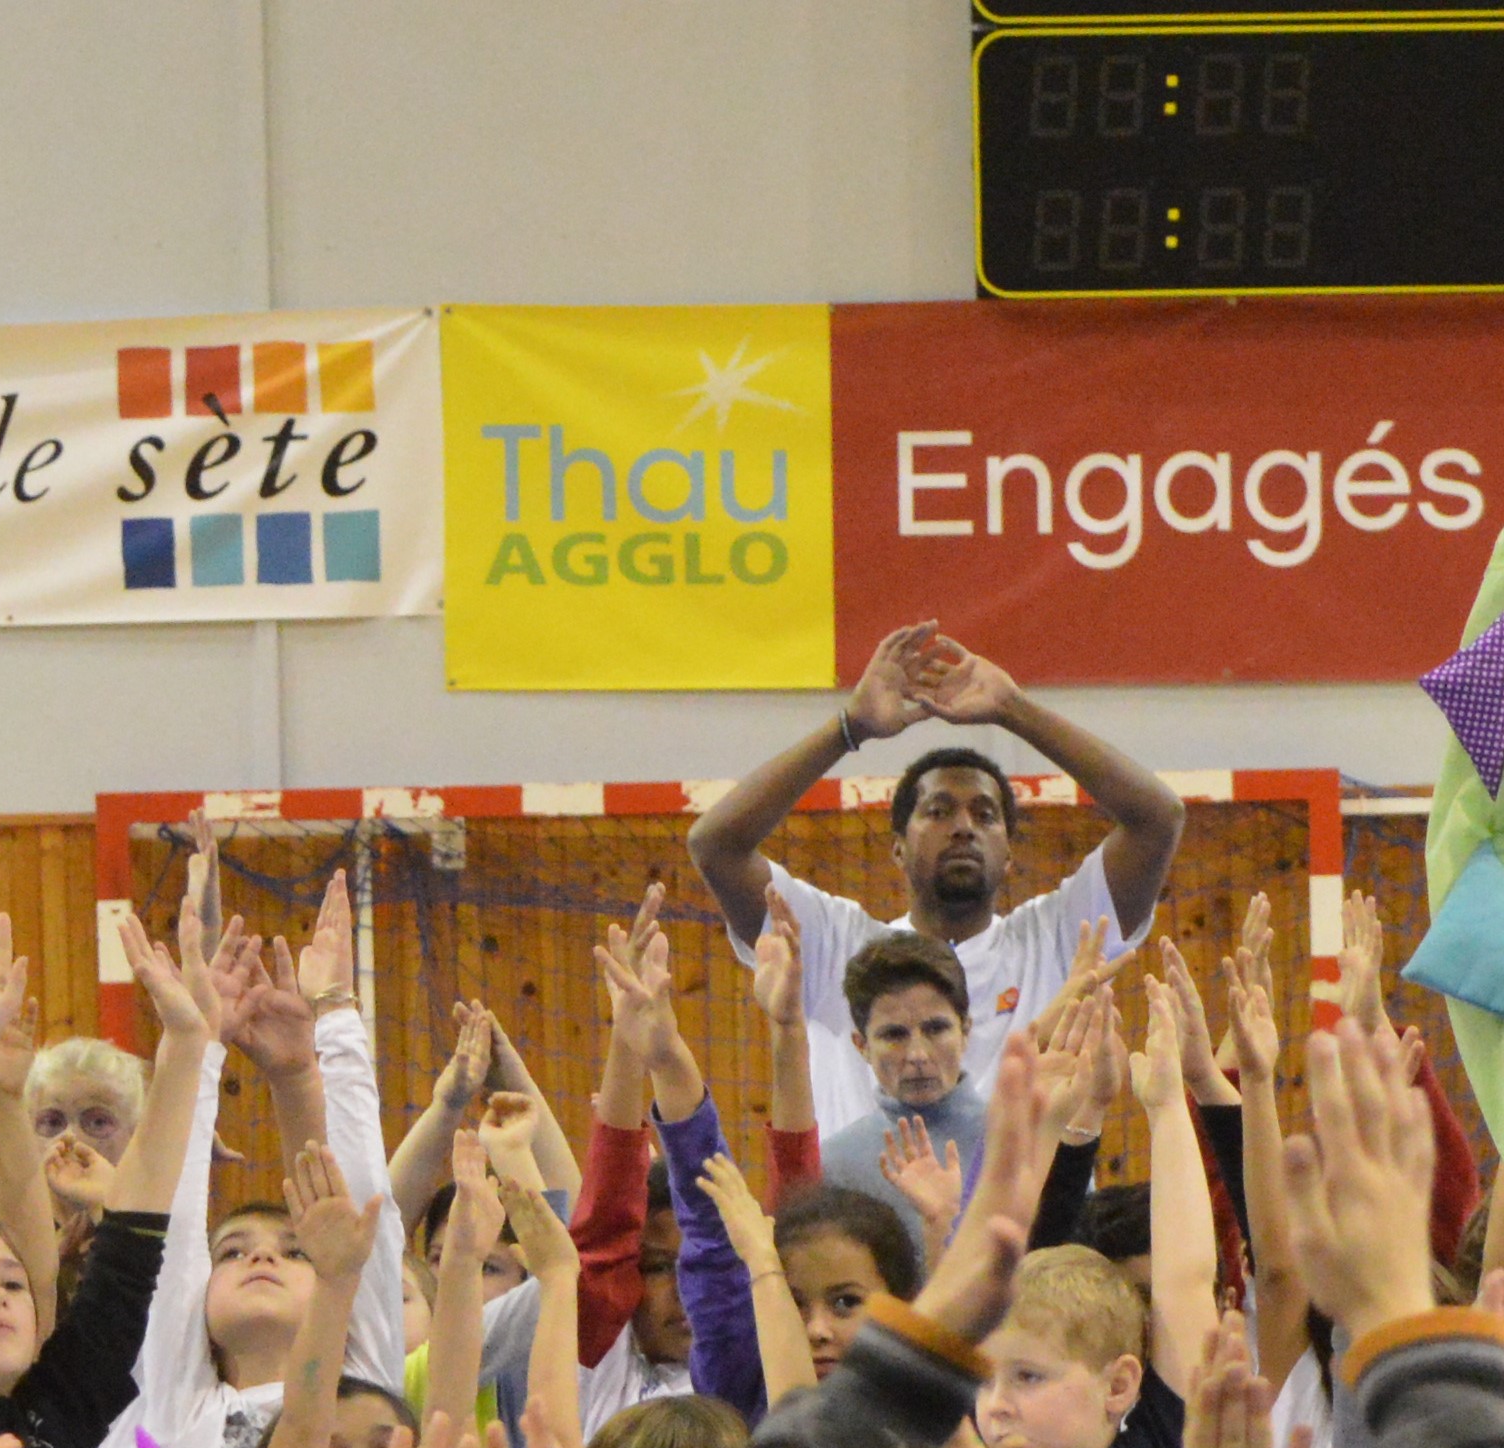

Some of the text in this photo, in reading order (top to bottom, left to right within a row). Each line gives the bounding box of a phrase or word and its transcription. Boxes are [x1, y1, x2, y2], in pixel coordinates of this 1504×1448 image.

[116, 391, 380, 503] sète
[481, 424, 789, 523] Thau
[897, 420, 1486, 569] Engagés
[484, 531, 789, 586] AGGLO
